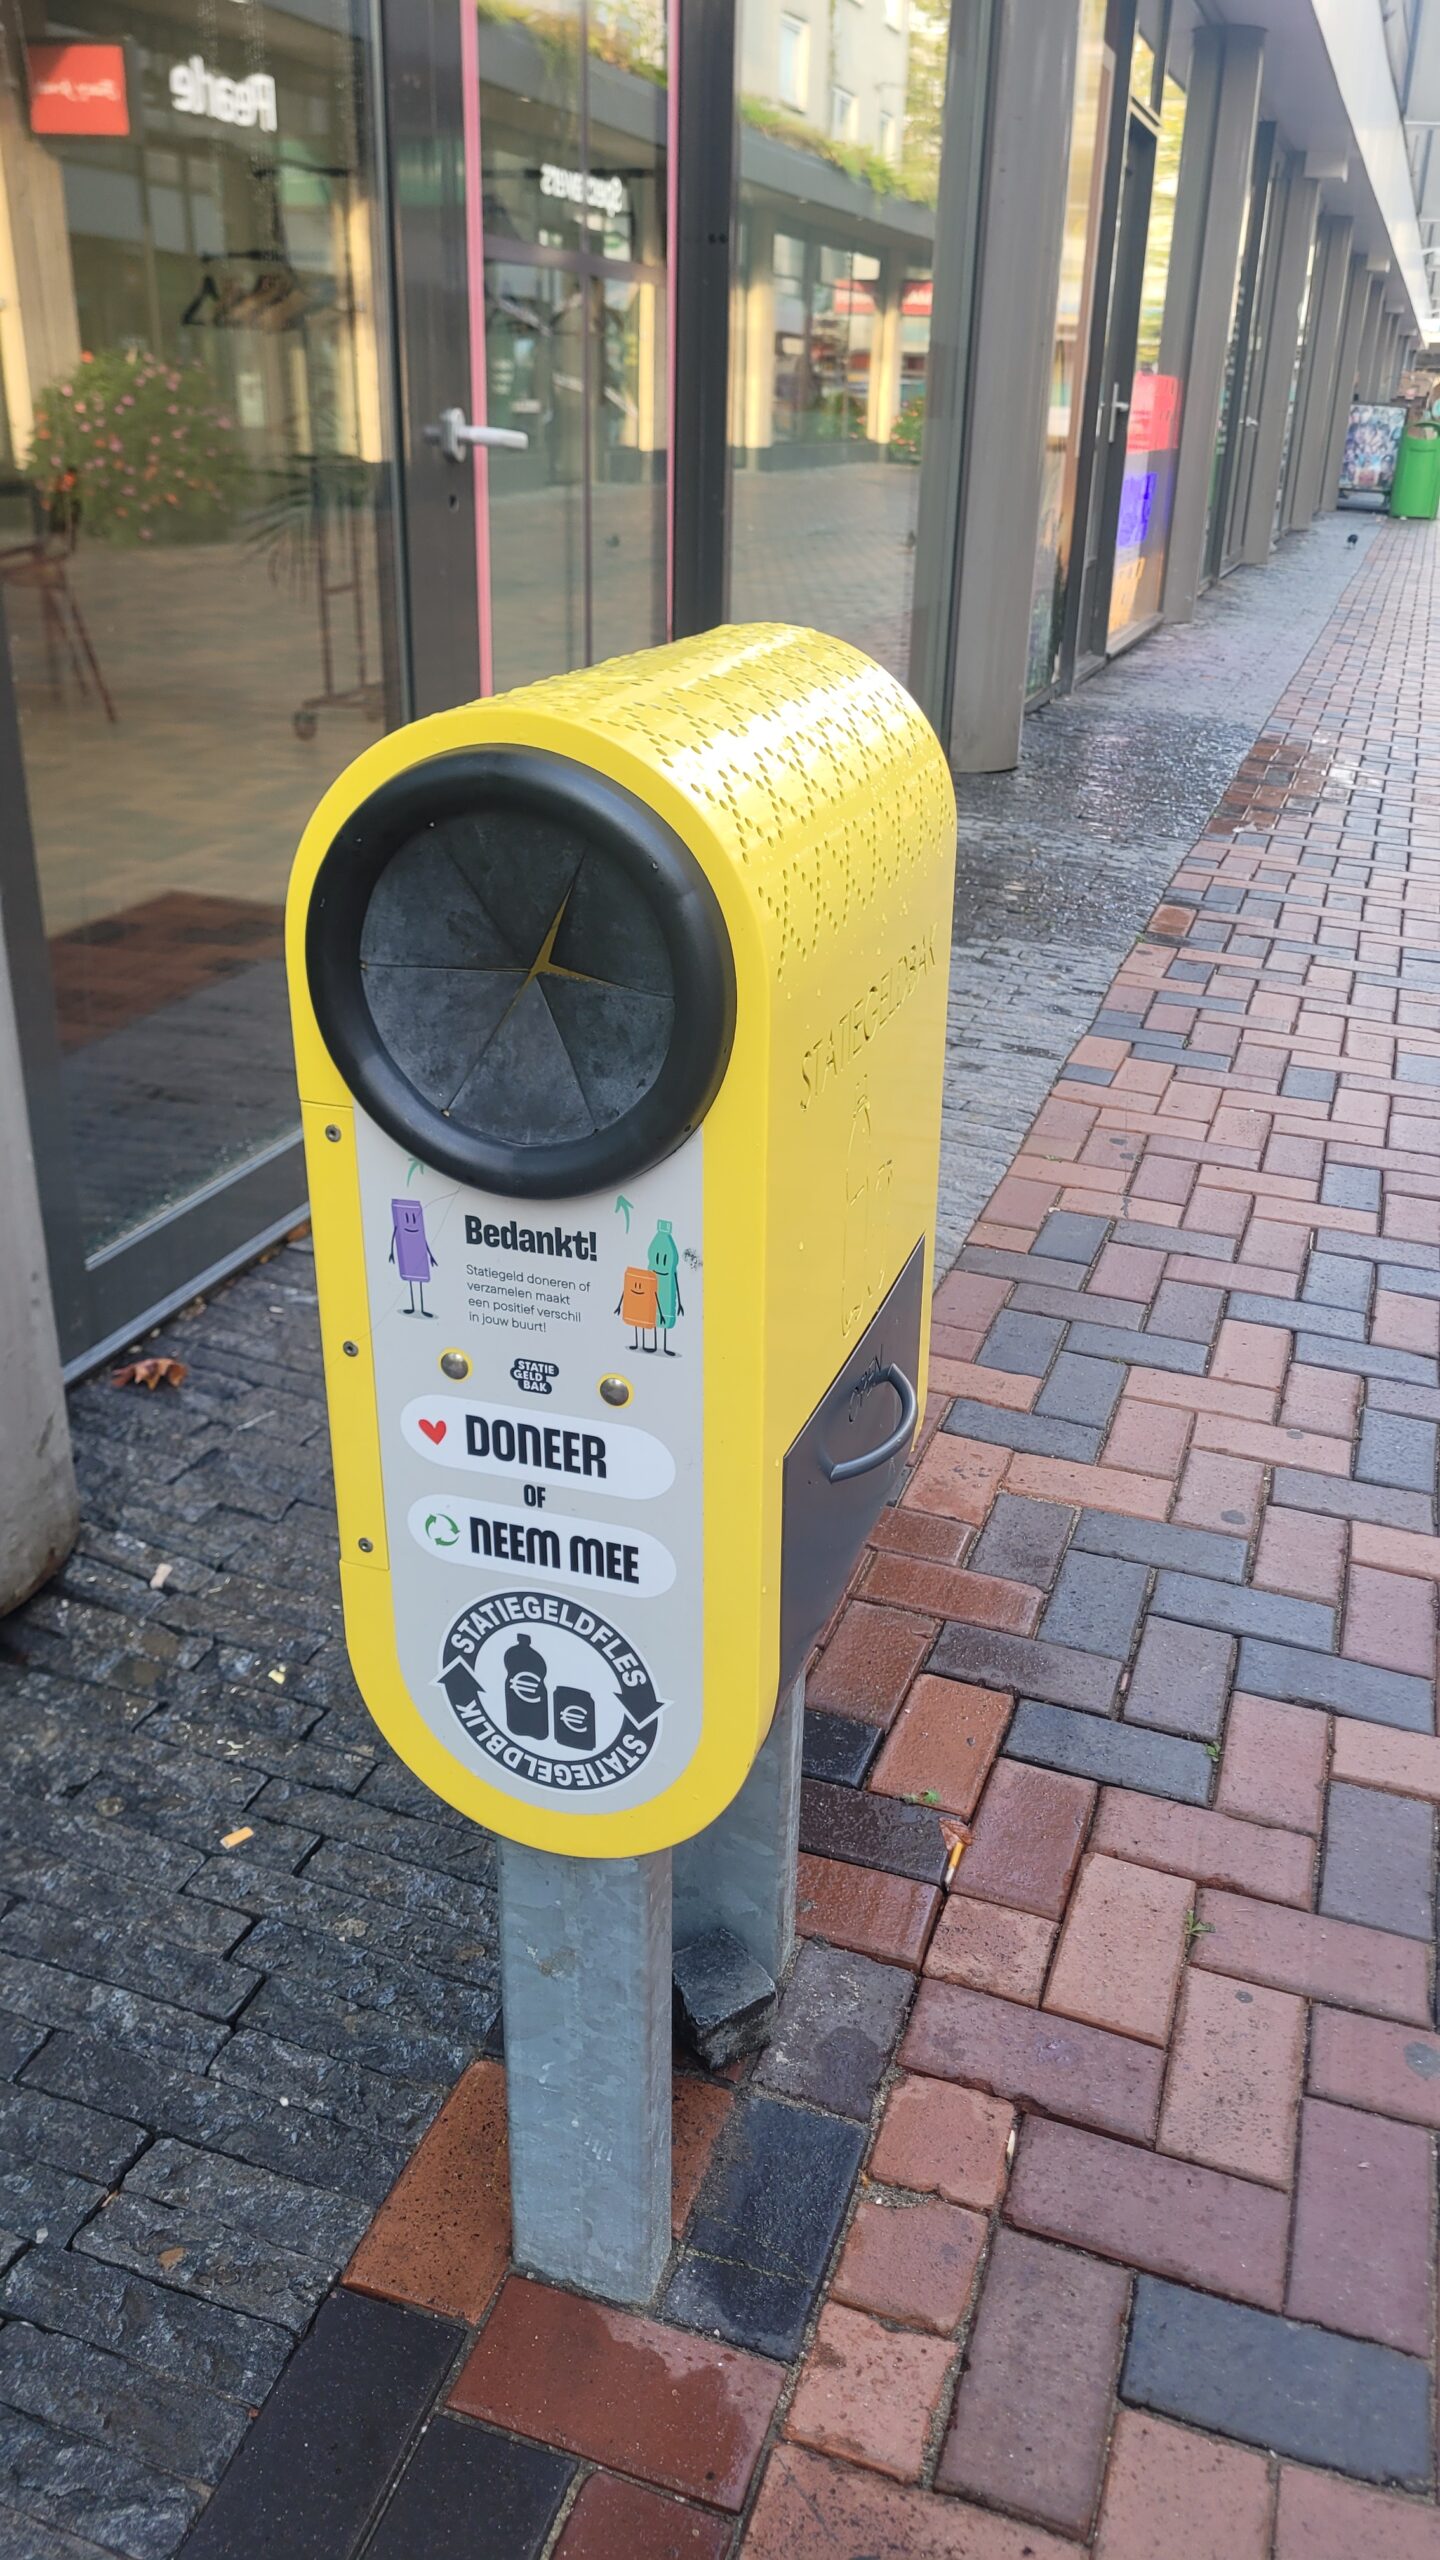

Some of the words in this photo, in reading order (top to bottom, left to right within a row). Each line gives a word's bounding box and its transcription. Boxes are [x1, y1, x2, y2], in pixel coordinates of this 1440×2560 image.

[800, 922, 938, 1111] STATIEGELDBAK
[464, 1214, 598, 1262] Bedankt!
[466, 1264, 524, 1283] Statiegeld
[526, 1273, 576, 1291] doneren
[578, 1281, 591, 1293] of
[467, 1282, 533, 1300] verzamelen
[535, 1292, 571, 1306] maakt
[468, 1297, 490, 1309] een
[493, 1301, 535, 1316] positief
[536, 1307, 582, 1323] verschil
[468, 1311, 480, 1323] in
[481, 1313, 509, 1326] jouw
[511, 1317, 547, 1333] buurt!
[513, 1369, 544, 1382] GELD
[517, 1360, 555, 1375] STATIE
[523, 1379, 548, 1393] BAK
[465, 1414, 607, 1479] DONEER
[523, 1484, 546, 1508] OF
[469, 1516, 561, 1569] NEEM
[569, 1535, 640, 1585] MEE
[450, 1595, 647, 1688] STATIEGELDFLES
[509, 1671, 541, 1703] €
[559, 1705, 588, 1733] €
[455, 1699, 648, 1787] STATIEGELDBLIK
